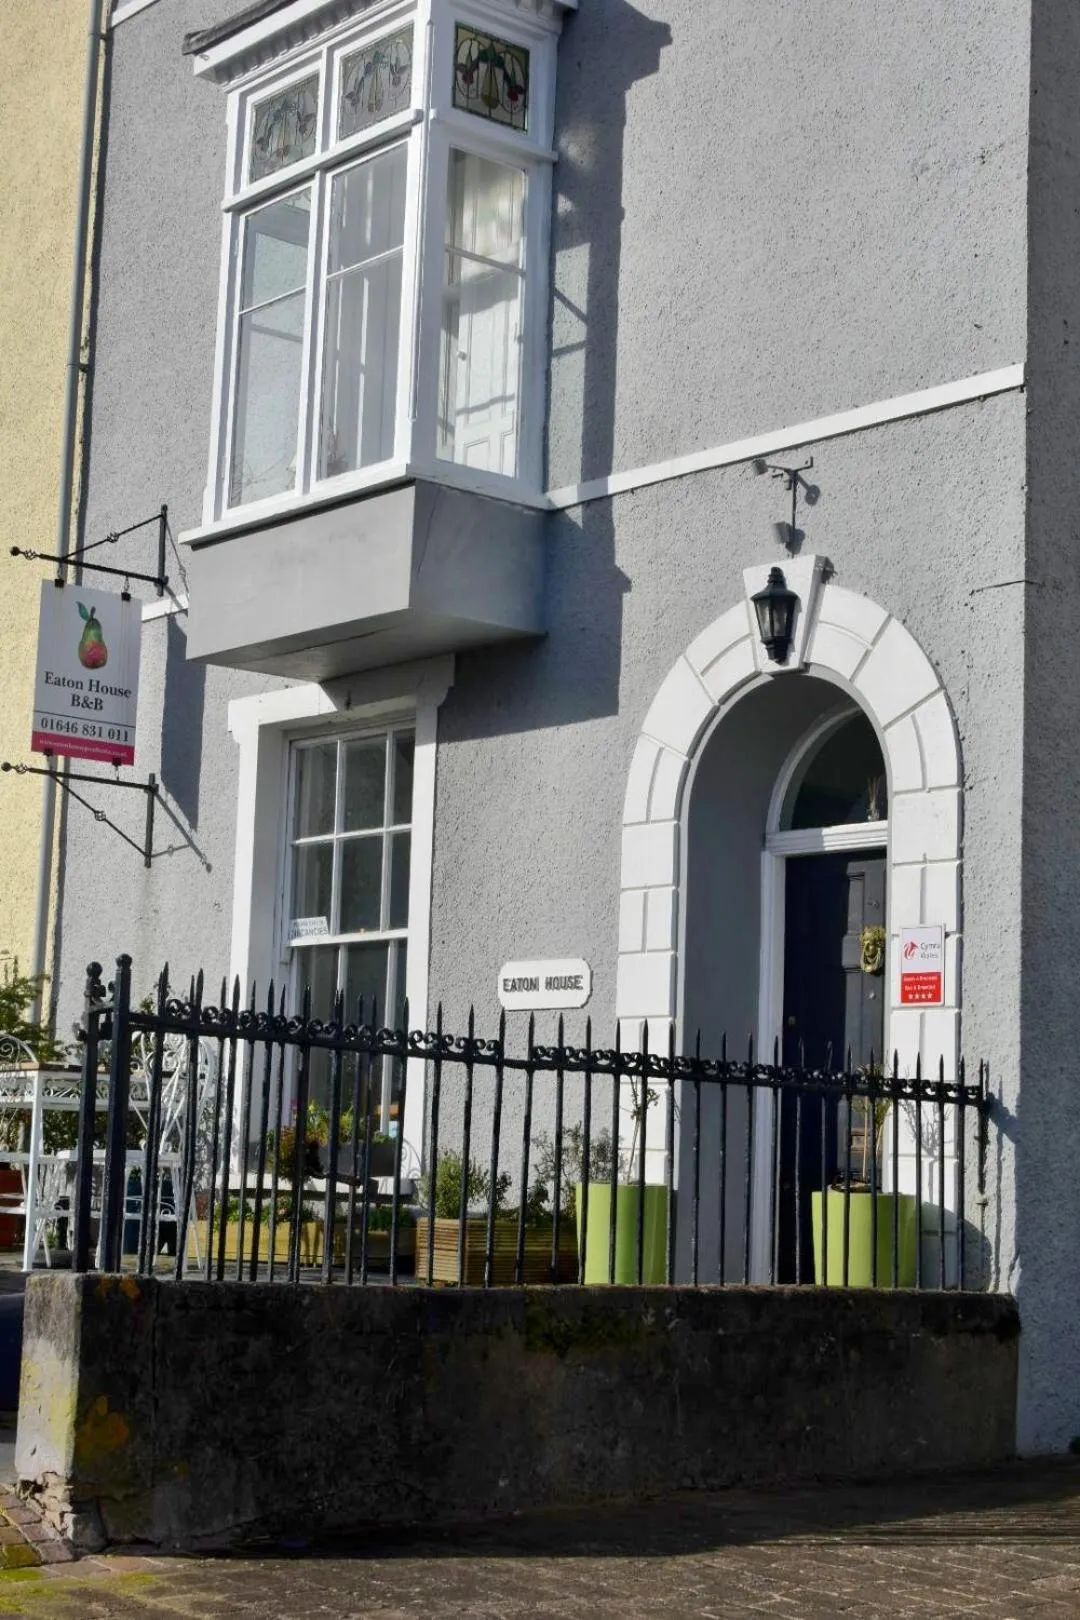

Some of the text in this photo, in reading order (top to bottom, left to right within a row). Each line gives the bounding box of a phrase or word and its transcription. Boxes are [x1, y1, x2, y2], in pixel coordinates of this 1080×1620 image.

[44, 671, 132, 698] Eaton House
[71, 693, 104, 711] B&B
[40, 717, 129, 742] 01646 831 011
[502, 975, 584, 992] EATON HOUSE
